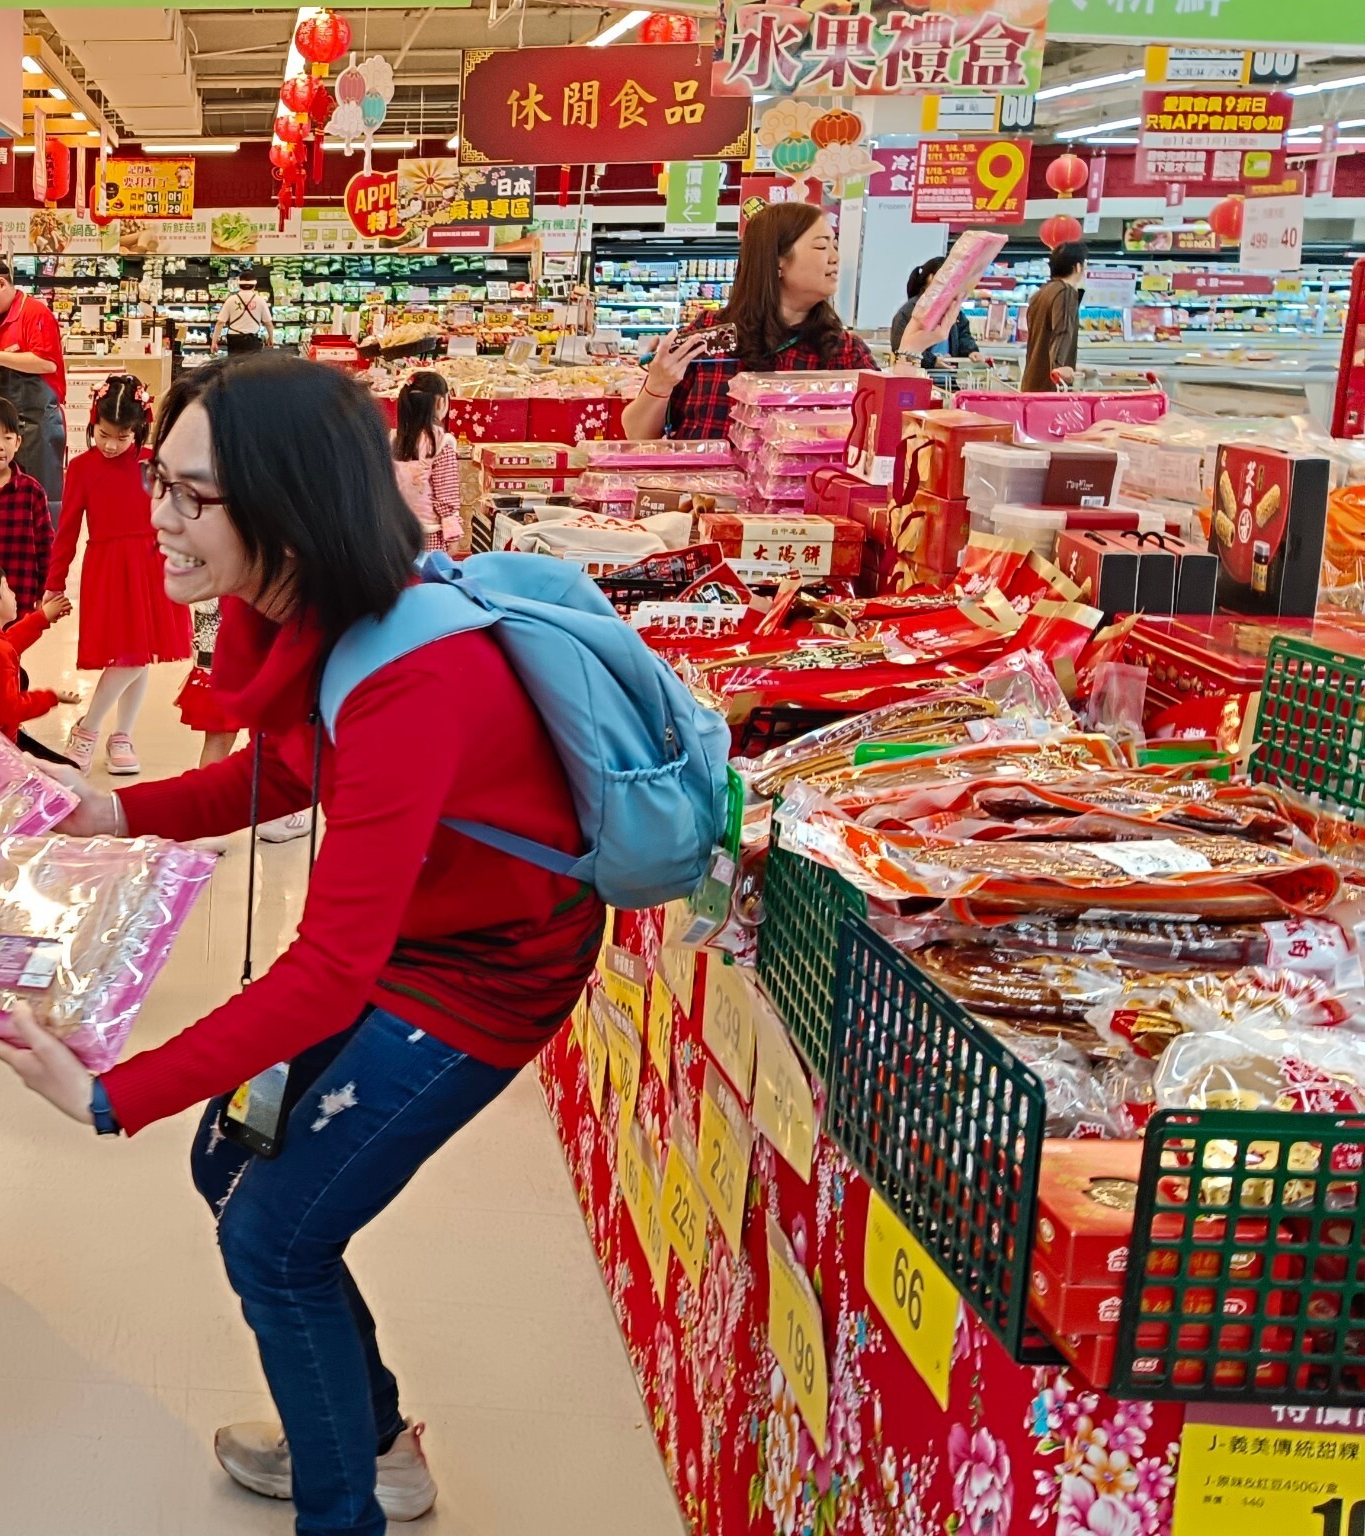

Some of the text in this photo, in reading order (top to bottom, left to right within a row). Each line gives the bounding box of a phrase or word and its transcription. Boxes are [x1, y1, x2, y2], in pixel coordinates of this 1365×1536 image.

[725, 12, 1035, 91] 水果禮盒
[506, 79, 706, 131] 休閒食品
[449, 198, 531, 220] 蘋果專區
[497, 178, 531, 197] 日本
[1280, 228, 1298, 247] 40
[714, 984, 742, 1052] 239
[711, 1138, 735, 1213] 225
[671, 1183, 697, 1252] 225
[892, 1248, 925, 1331] 66
[786, 1308, 815, 1394] 199
